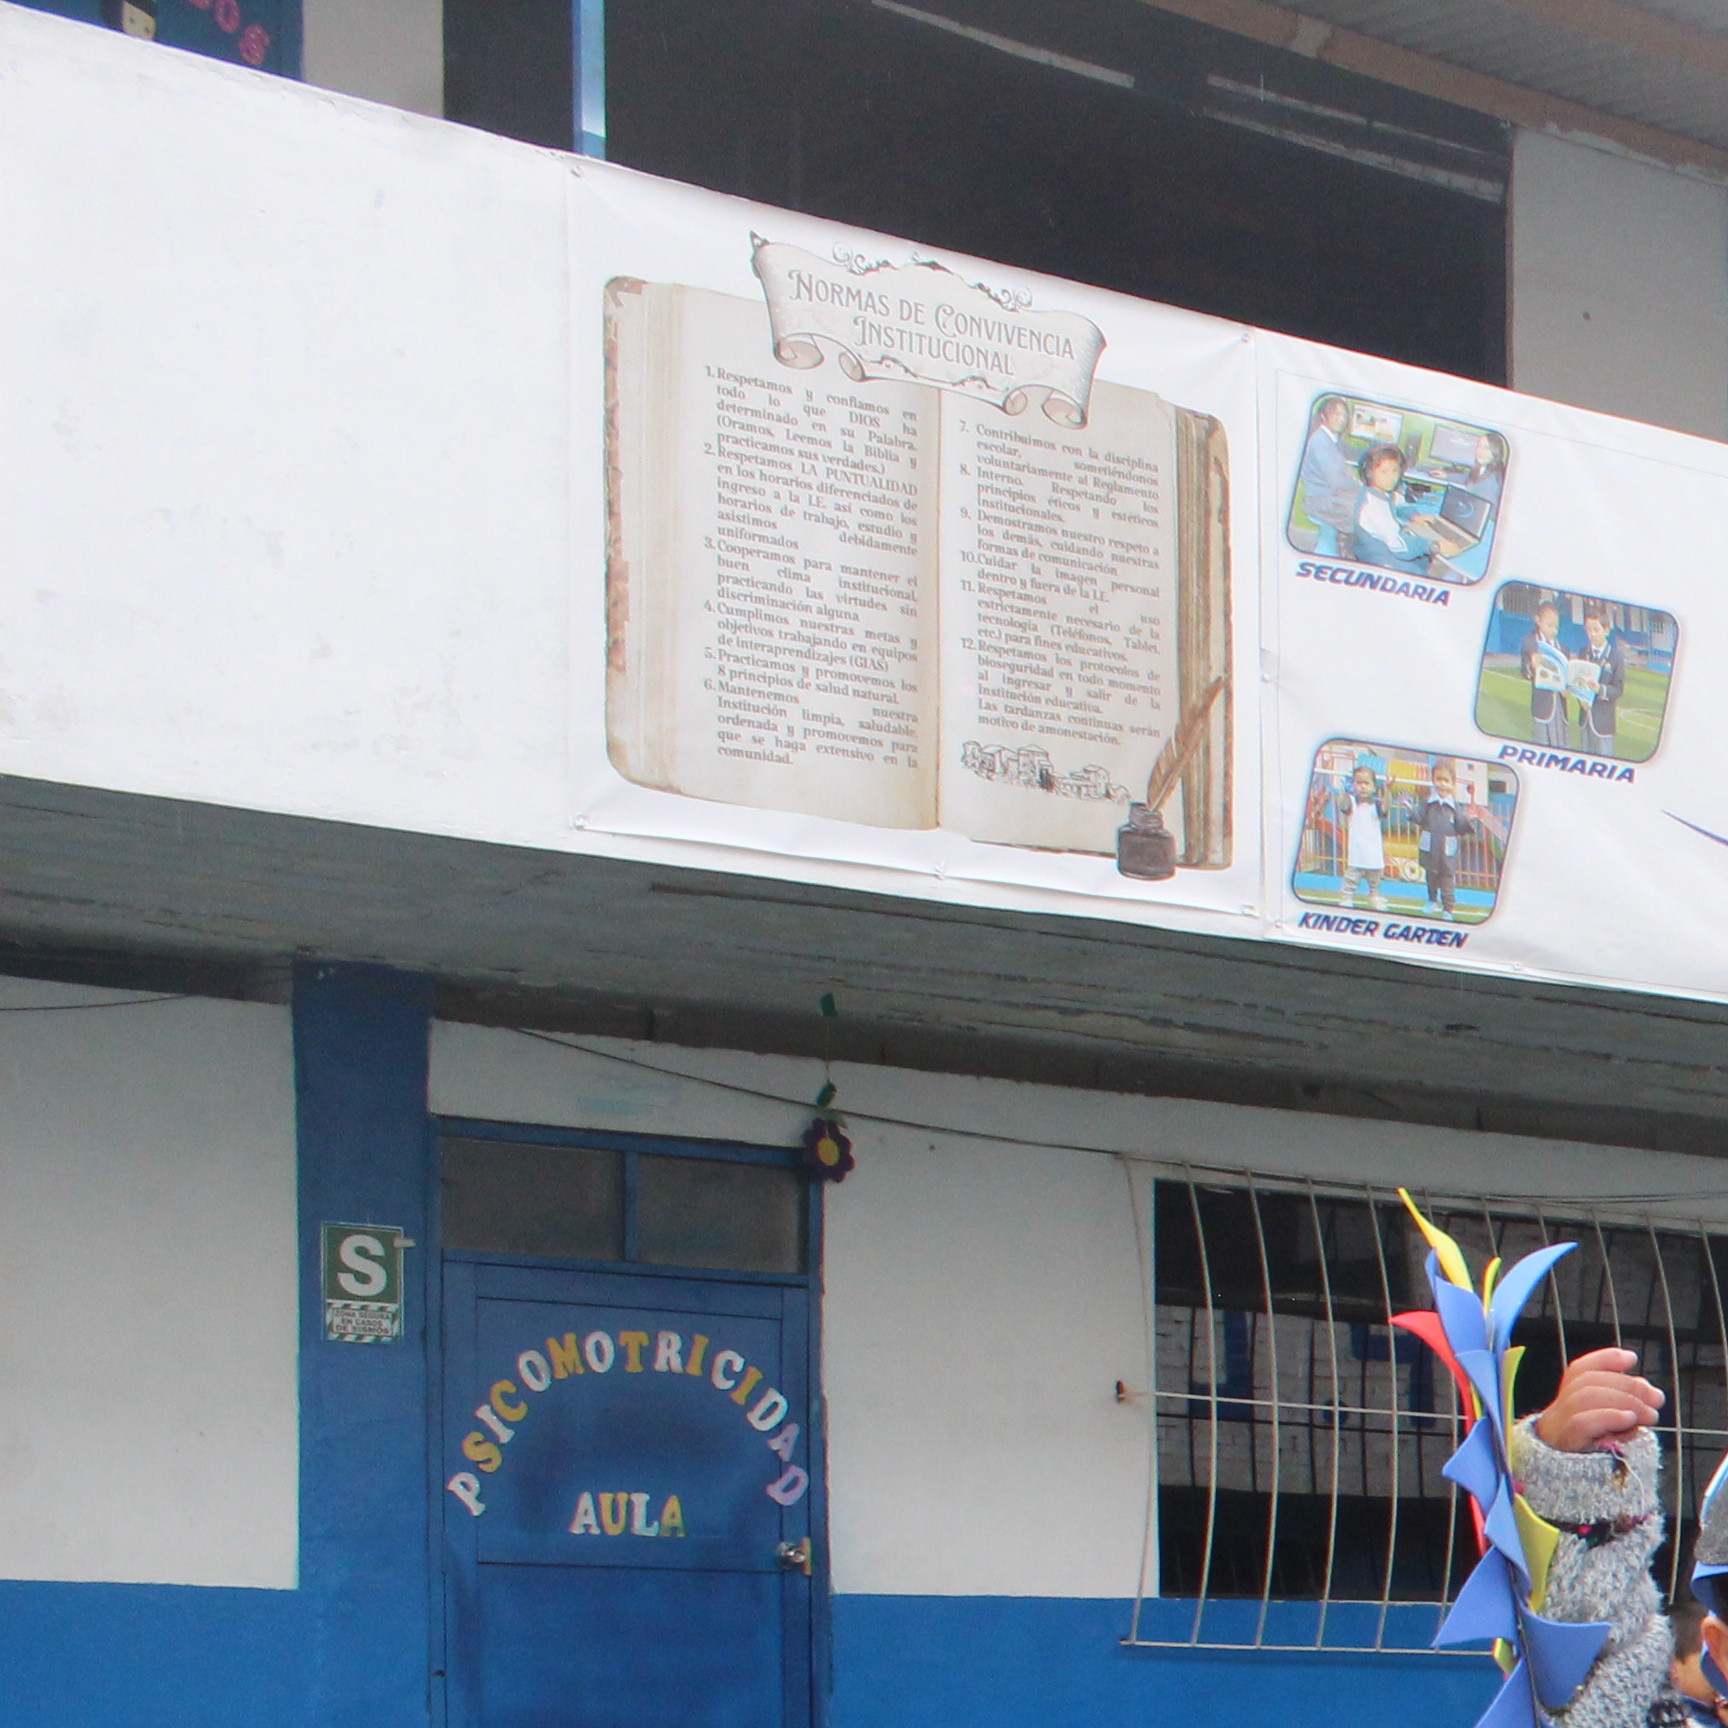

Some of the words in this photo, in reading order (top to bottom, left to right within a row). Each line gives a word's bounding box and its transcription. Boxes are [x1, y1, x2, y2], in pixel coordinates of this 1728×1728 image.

[788, 269, 890, 316] NORMAS
[899, 297, 925, 326] DE
[935, 303, 1076, 360] CONVIVENCIA
[853, 314, 1016, 375] INSTITUCIONAL
[716, 367, 793, 398] Respetamos
[805, 389, 813, 403] y
[825, 390, 890, 416] confiamos
[901, 409, 917, 421] en
[716, 382, 746, 401] todo
[767, 393, 781, 408] lo
[802, 403, 826, 420] que
[848, 410, 881, 429] DIOS
[902, 421, 917, 436] ha
[715, 398, 799, 427] determinado
[810, 420, 827, 433] en
[839, 426, 855, 438] su
[867, 429, 916, 450] Palabra.
[716, 429, 795, 460] practicamos
[797, 448, 819, 462] sus
[785, 427, 832, 449] Leemos
[842, 439, 854, 453] la
[864, 443, 900, 463] Biblia
[909, 455, 917, 469] y
[716, 462, 733, 475] en
[736, 463, 755, 479] los
[758, 468, 813, 491] horarios
[815, 479, 900, 508] diferenciados
[902, 496, 917, 511] de
[717, 444, 793, 474] Respetamos
[800, 461, 818, 476] LA
[825, 466, 918, 496] PUNTUALIDAD
[716, 476, 766, 500] ingreso
[772, 489, 781, 500] a
[788, 489, 800, 504] la
[833, 498, 852, 514] así
[859, 506, 893, 521] como
[900, 511, 917, 526] los
[1296, 561, 1451, 606] SECUNDARIA
[1497, 745, 1636, 784] PRIMARIA
[1299, 912, 1379, 937] KINDER
[1382, 924, 1469, 949] GARTEN
[338, 1234, 387, 1297] S
[447, 1330, 810, 1518] PSICOMOTRICIDAD
[569, 1492, 688, 1538] AULA
